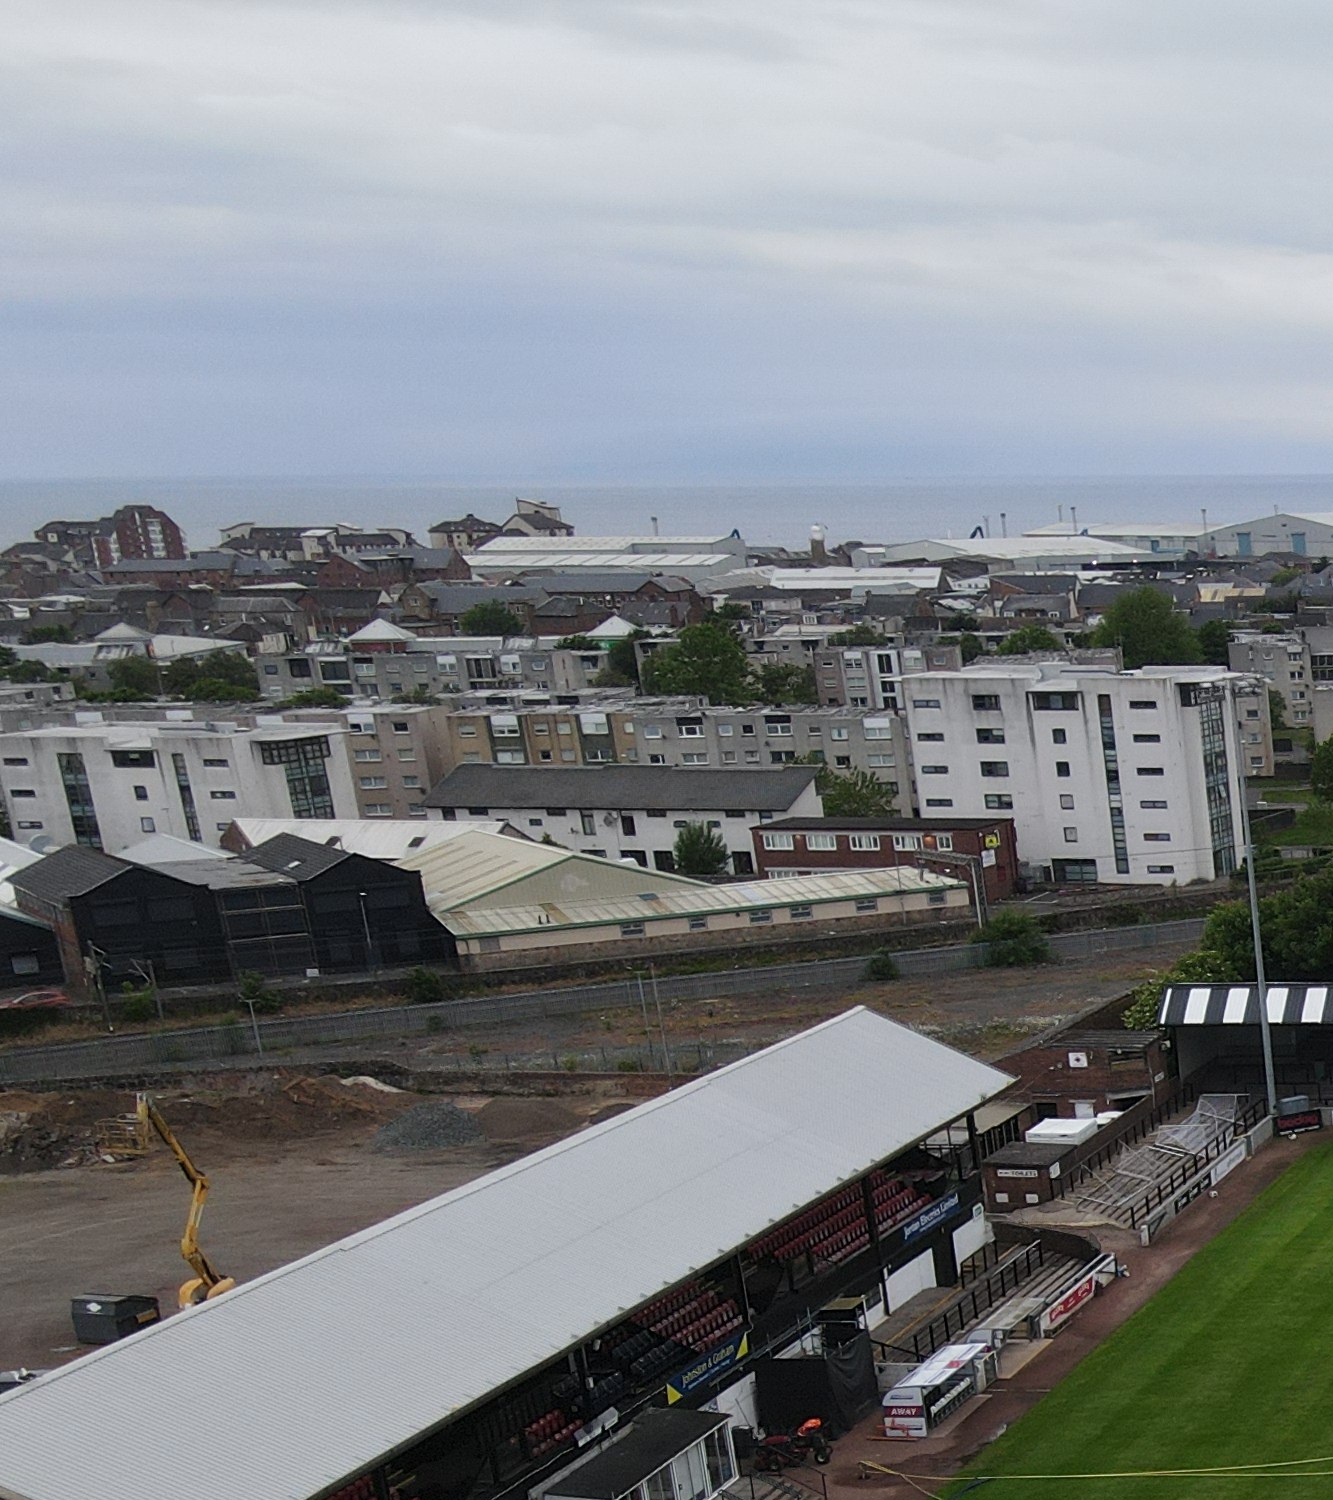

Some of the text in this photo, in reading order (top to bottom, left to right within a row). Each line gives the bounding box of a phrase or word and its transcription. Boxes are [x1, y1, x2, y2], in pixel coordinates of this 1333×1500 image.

[940, 1193, 958, 1214] Limited
[682, 1362, 708, 1389] Johnston
[890, 1407, 917, 1416] AWAY
